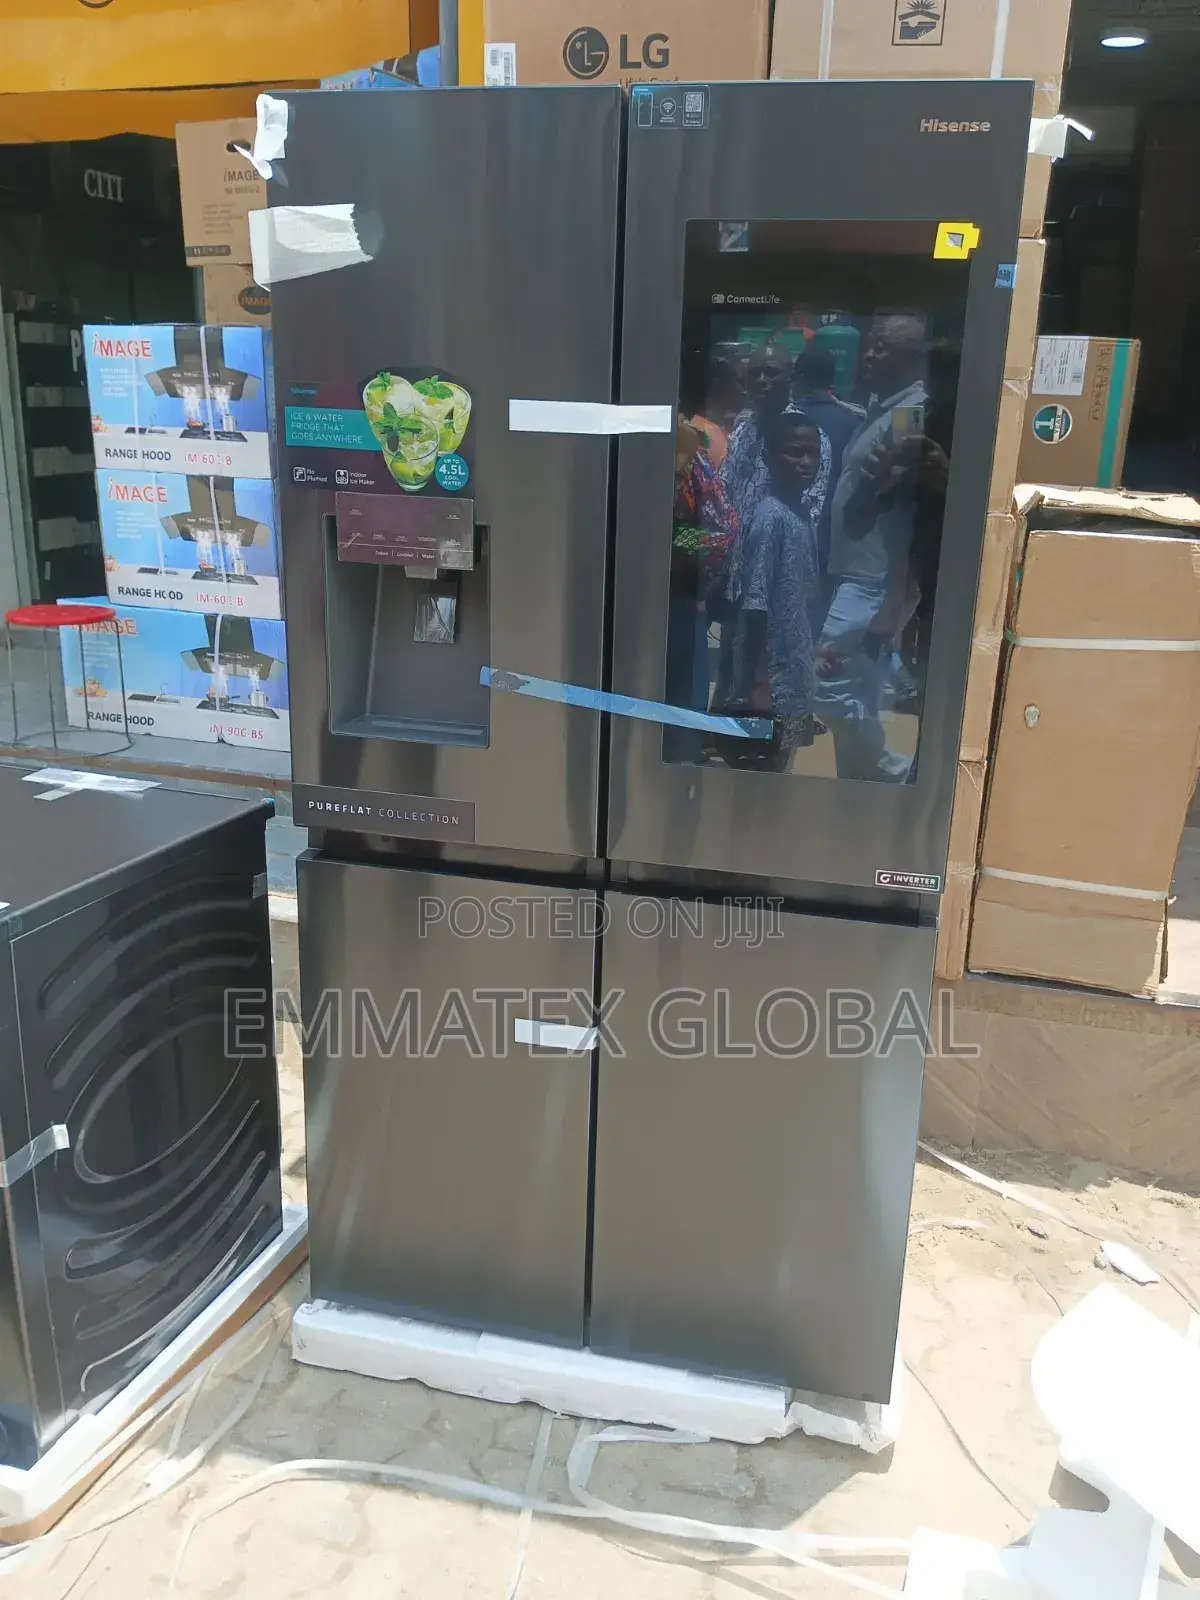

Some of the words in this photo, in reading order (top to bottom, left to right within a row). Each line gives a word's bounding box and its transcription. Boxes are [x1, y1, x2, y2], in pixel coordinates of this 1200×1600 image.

[619, 32, 670, 69] LG
[919, 118, 991, 132] Hisense
[83, 168, 124, 203] CITI
[726, 294, 780, 304] ConnectLife
[93, 331, 153, 358] iMAGE
[290, 412, 304, 420] ICE
[305, 413, 313, 421] &
[313, 413, 344, 422] WATER
[291, 422, 320, 431] FRIDGE
[323, 423, 345, 432] THAT
[291, 432, 314, 440] GOES
[316, 433, 363, 444] ANYWHERE
[104, 448, 138, 459] RANGE
[142, 449, 172, 461] HOOD
[439, 464, 466, 476] 4.5L
[358, 478, 375, 486] Maker
[108, 477, 168, 503] iMAGE
[117, 586, 152, 598] RANGE
[87, 711, 122, 723] RANGE
[125, 713, 155, 727] HOOD
[308, 800, 372, 815] PUREFLAT
[378, 807, 460, 825] COLLECTION
[893, 875, 936, 885] INVERTER
